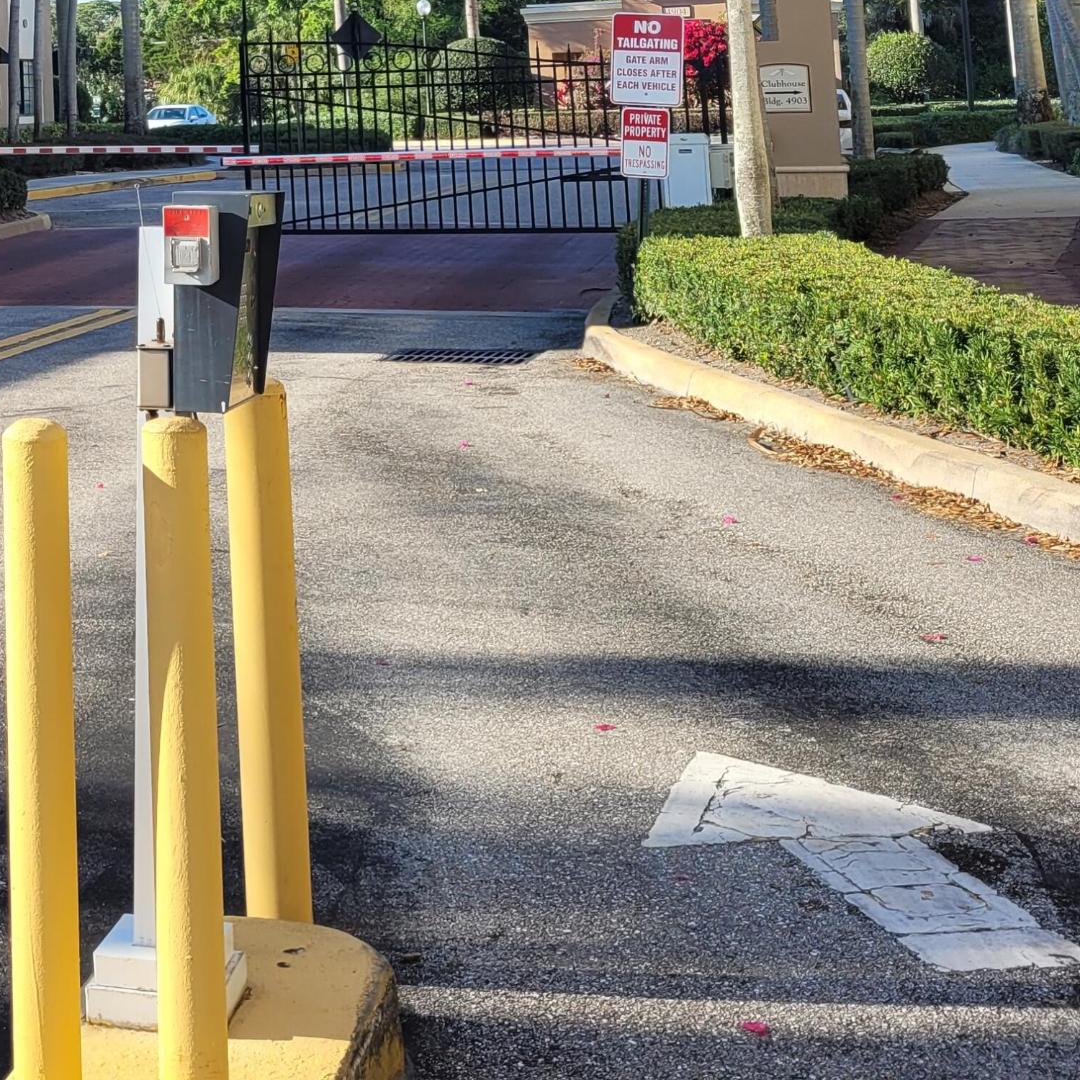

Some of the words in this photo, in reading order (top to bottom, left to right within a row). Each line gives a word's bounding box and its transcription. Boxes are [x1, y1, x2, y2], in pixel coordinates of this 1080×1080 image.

[634, 20, 661, 34] NO
[617, 37, 678, 50] TAILGATING
[626, 55, 647, 65] GATE
[650, 56, 669, 65] ARM
[617, 68, 648, 77] CLOSES
[651, 69, 677, 79] AFTER
[617, 81, 639, 90] EACH
[642, 82, 676, 92] VEHICLE
[761, 80, 806, 88] Clubhouse
[786, 97, 808, 105] 4903
[630, 113, 662, 125] PRIVATE
[624, 125, 667, 138] PROPERTY
[639, 145, 652, 158] NO
[624, 159, 665, 170] TRESPASSING
